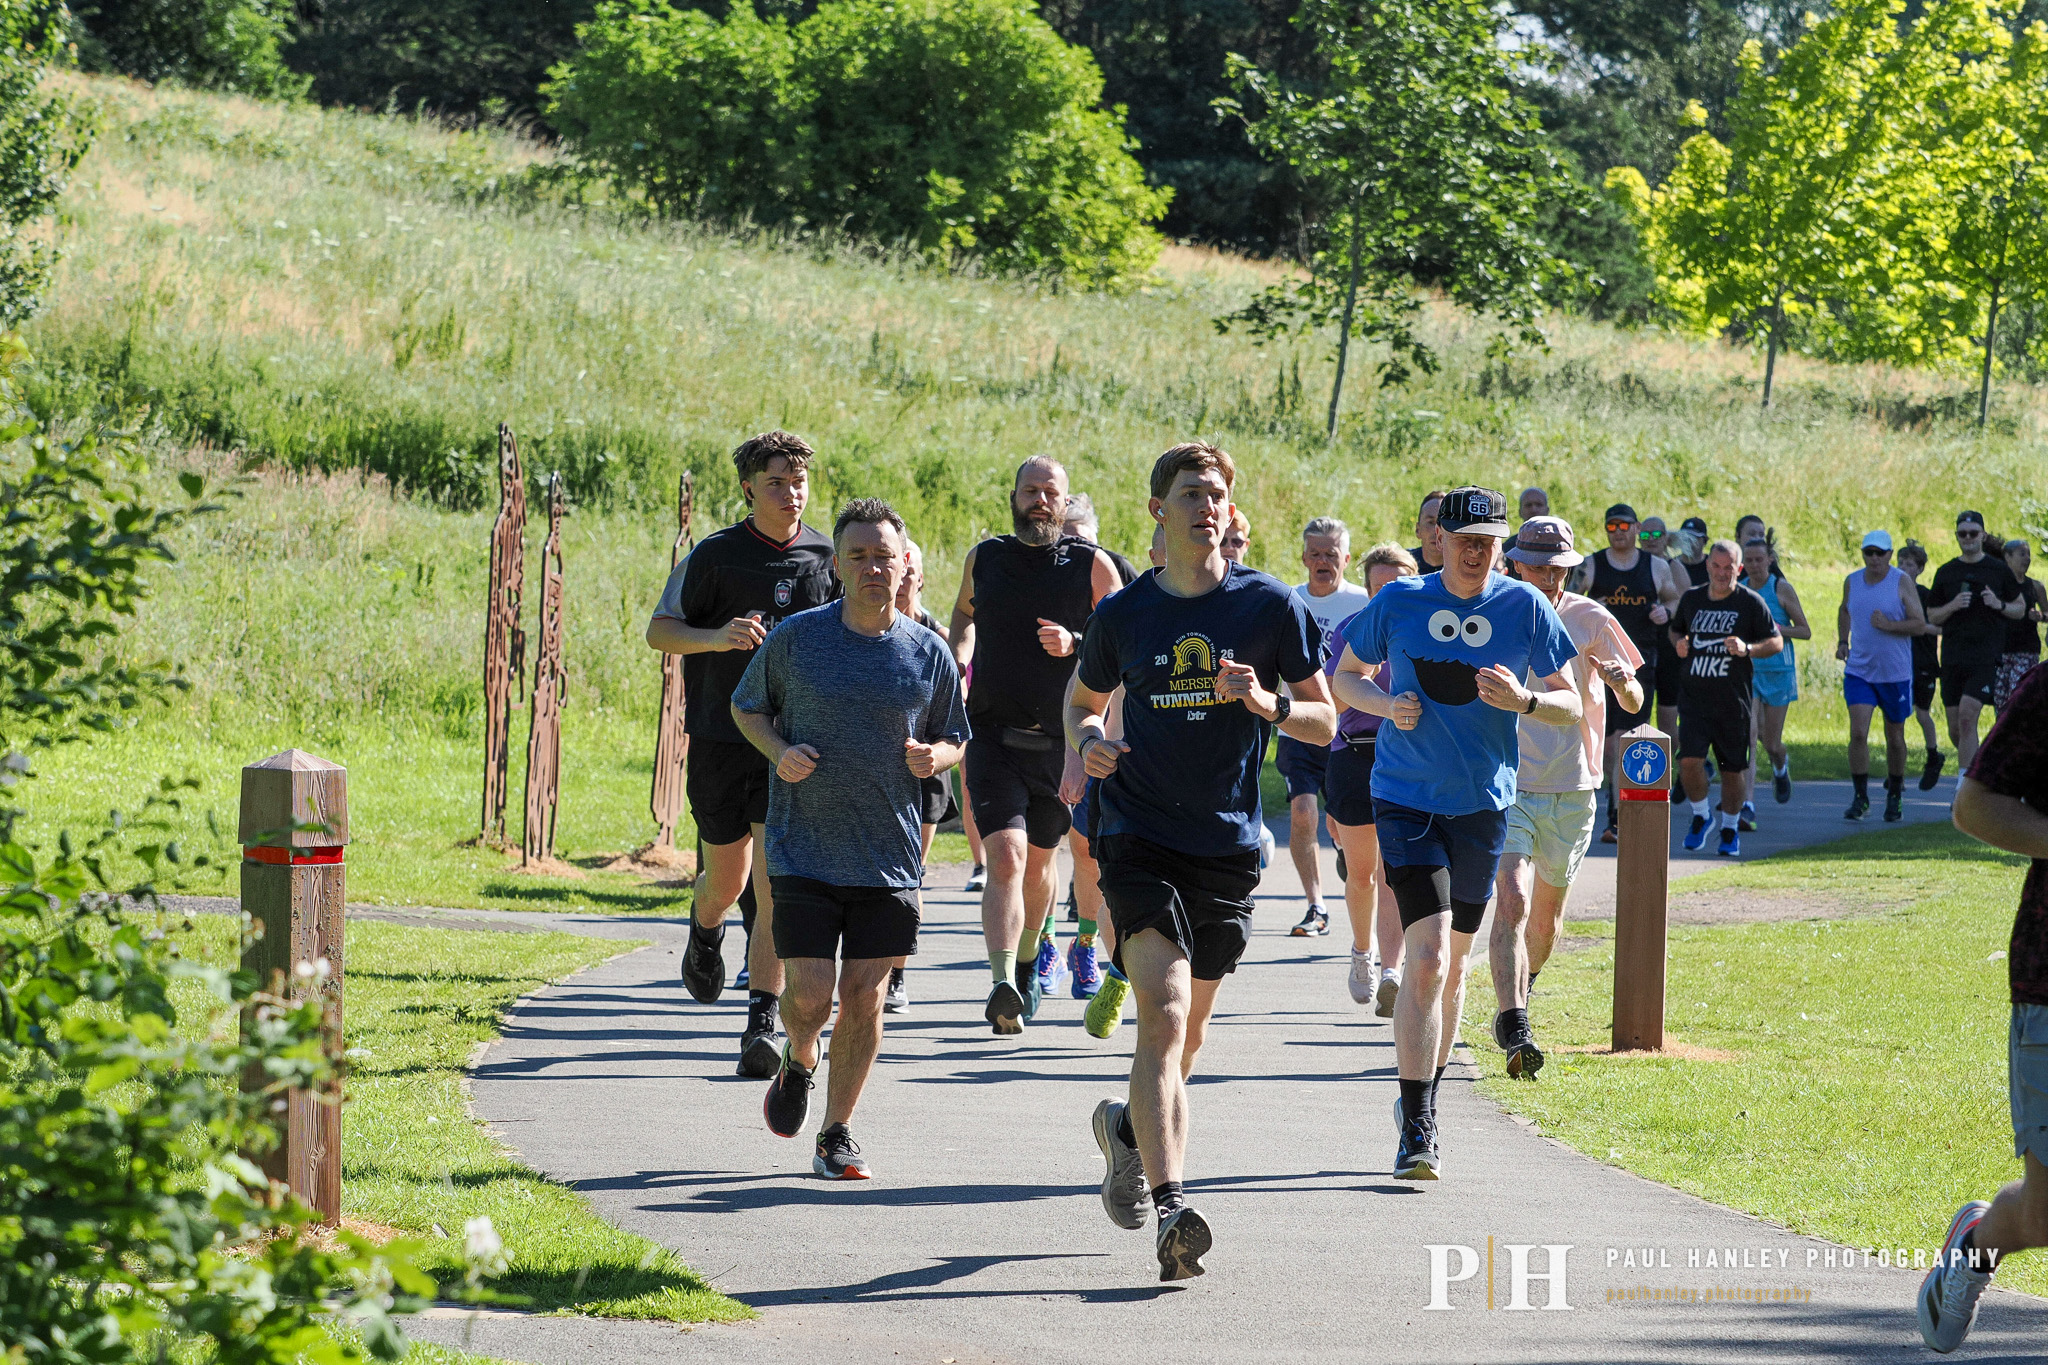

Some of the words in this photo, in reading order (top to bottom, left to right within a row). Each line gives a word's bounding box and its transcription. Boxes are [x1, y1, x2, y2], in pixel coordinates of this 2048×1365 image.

[1471, 503, 1487, 514] 66
[1314, 616, 1330, 627] HE
[1690, 610, 1739, 634] NIKE
[1175, 635, 1186, 645] RUN
[1187, 632, 1212, 643] TOWARDS
[1154, 654, 1168, 666] 20
[1220, 649, 1234, 659] 26
[1690, 656, 1733, 678] NIKE
[1169, 677, 1217, 691] MERSEY
